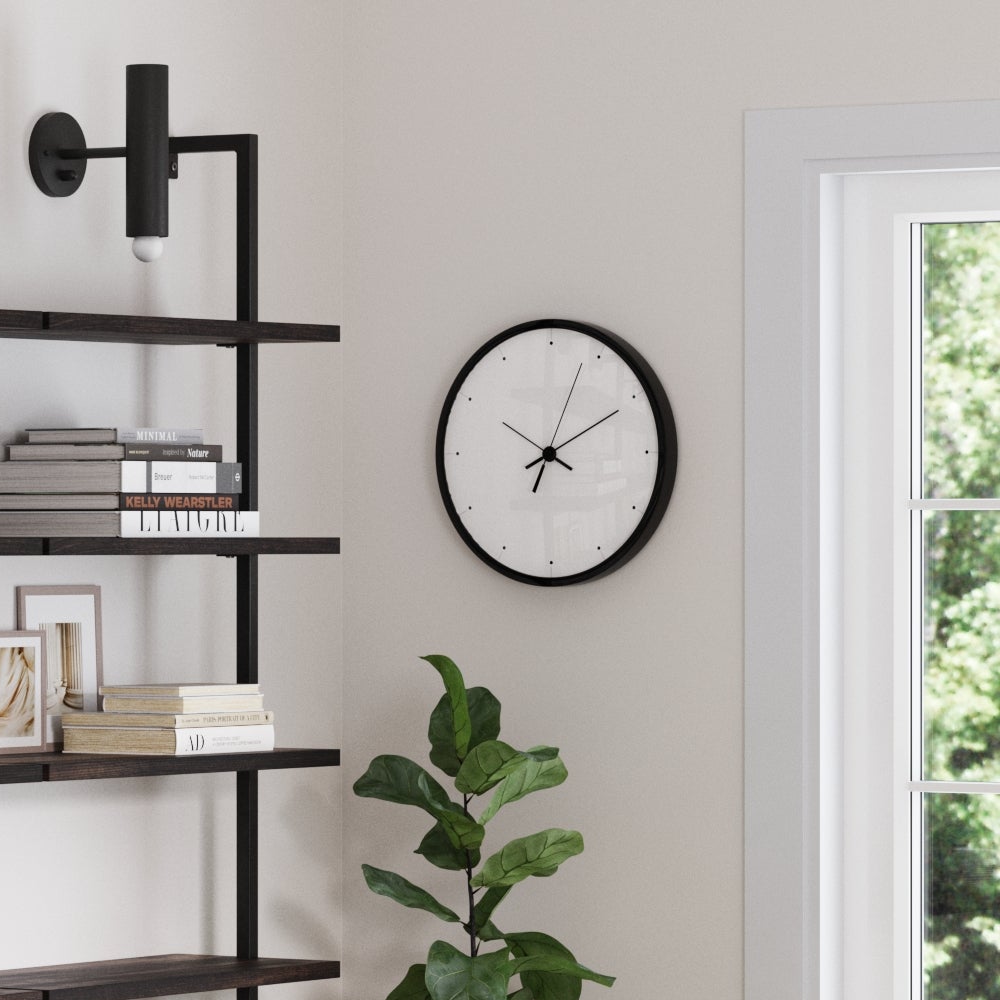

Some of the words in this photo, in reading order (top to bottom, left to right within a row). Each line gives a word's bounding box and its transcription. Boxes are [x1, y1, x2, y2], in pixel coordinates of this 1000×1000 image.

[136, 431, 178, 441] MINIMAL
[187, 448, 210, 458] Nature
[154, 472, 173, 481] Breuer
[125, 496, 161, 508] KELLY
[164, 496, 233, 508] WEARSTLER
[185, 733, 206, 752] AD
